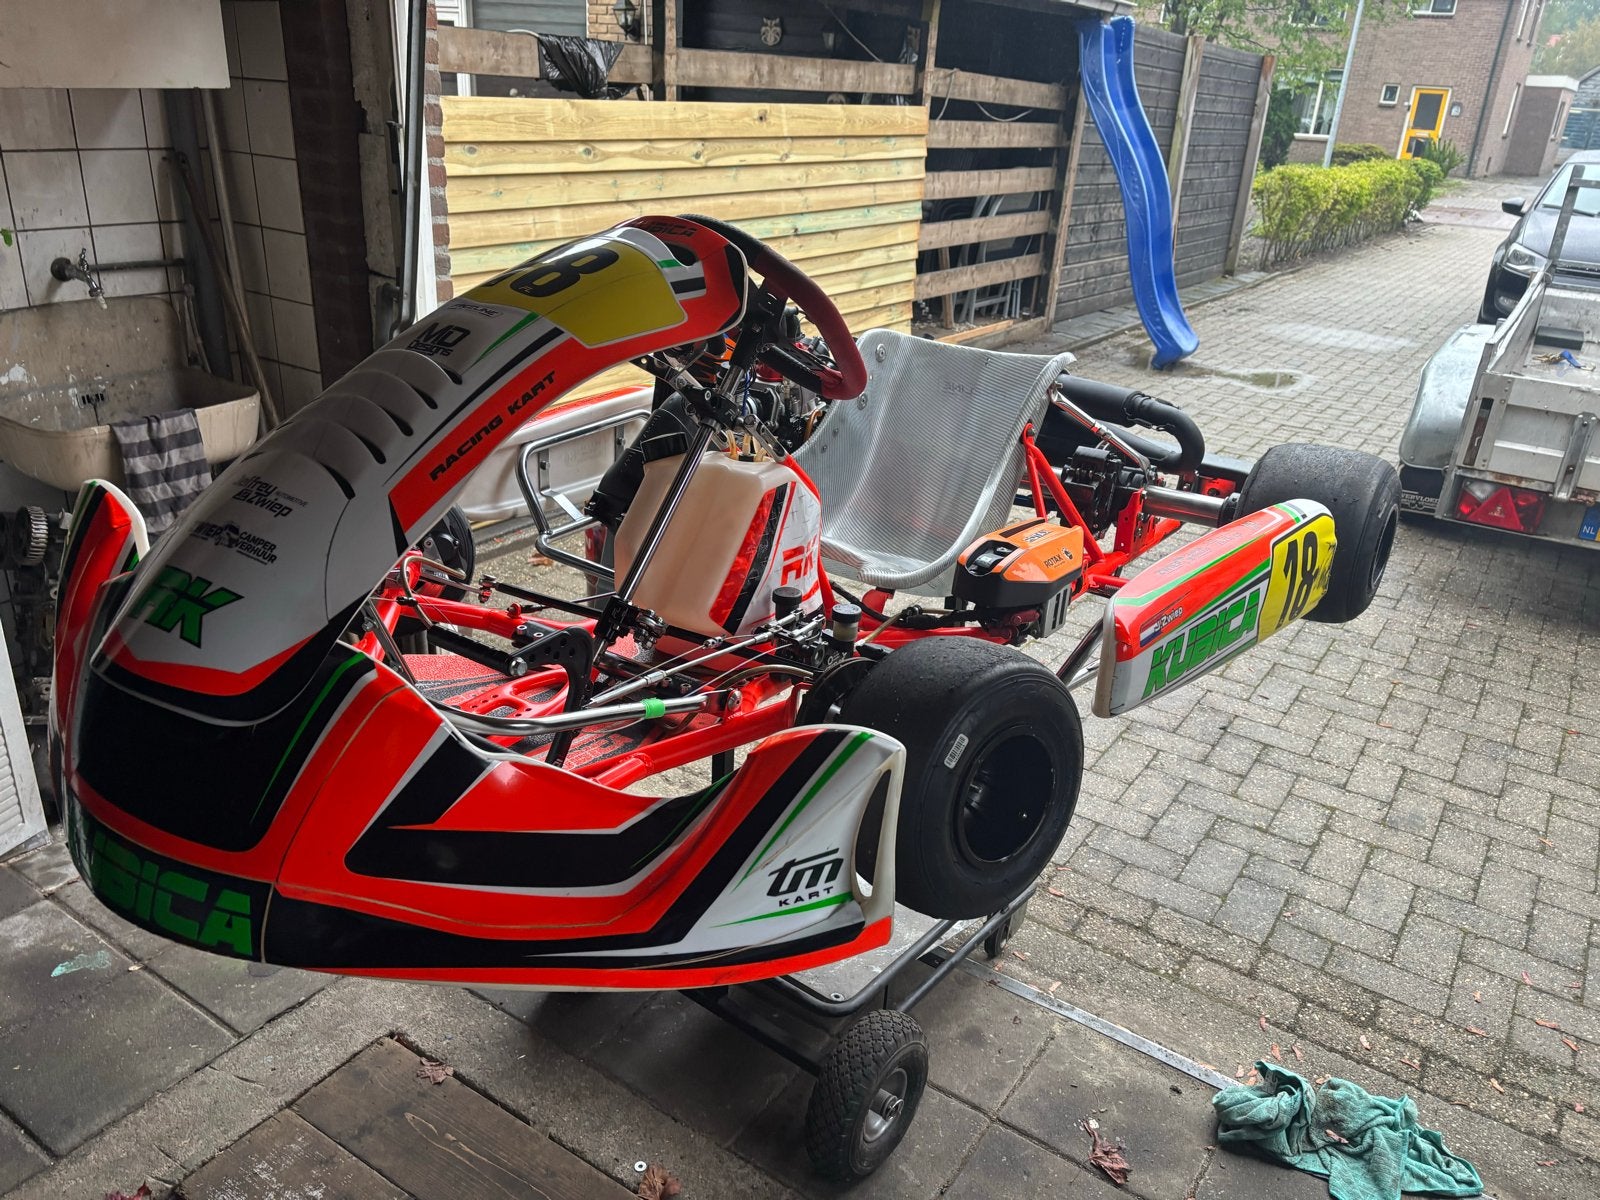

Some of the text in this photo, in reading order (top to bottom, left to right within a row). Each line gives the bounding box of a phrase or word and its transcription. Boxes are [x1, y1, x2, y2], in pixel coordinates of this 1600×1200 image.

[507, 370, 556, 416] KART
[1582, 524, 1595, 535] NL
[235, 541, 278, 564] VERHUUR
[240, 531, 277, 553] CAMPER
[1274, 530, 1319, 630] 18
[1140, 588, 1261, 700] KUBICA
[778, 886, 834, 907] KART
